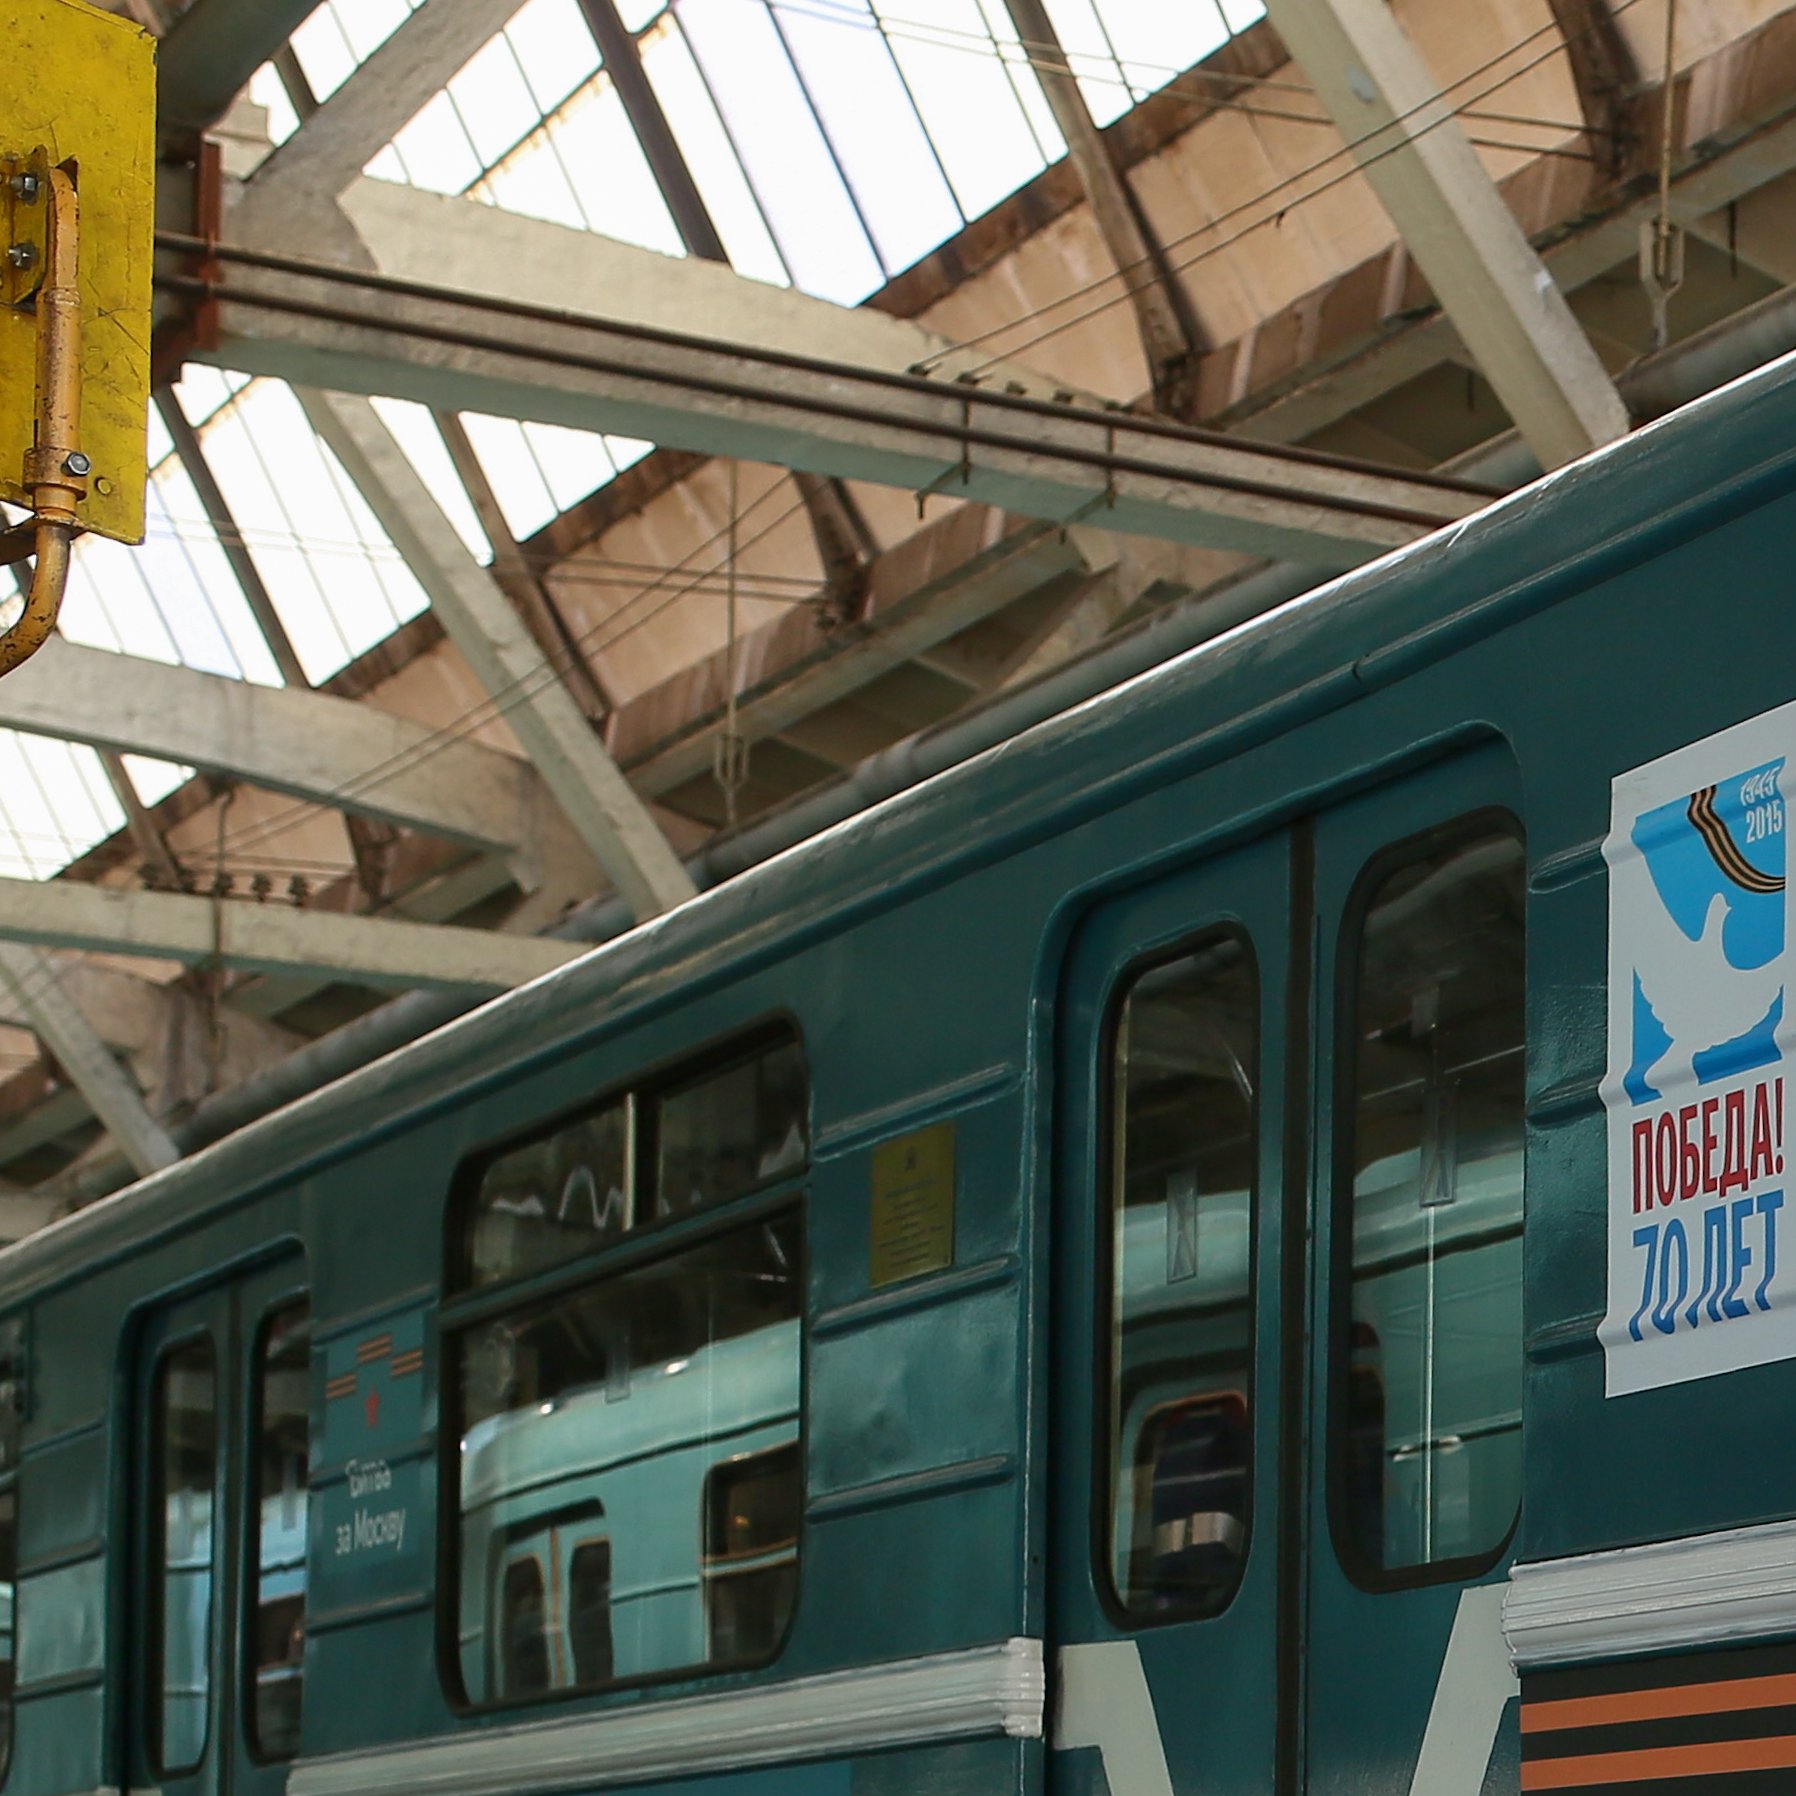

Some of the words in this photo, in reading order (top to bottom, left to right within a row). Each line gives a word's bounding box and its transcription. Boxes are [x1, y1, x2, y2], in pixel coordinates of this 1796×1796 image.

[1741, 766, 1780, 806] 1945
[1746, 799, 1782, 843] 2015
[1632, 1076, 1784, 1214] ПОБЕДА!
[1629, 1218, 1686, 1342] 70
[1686, 1190, 1785, 1330] ЛЕТ
